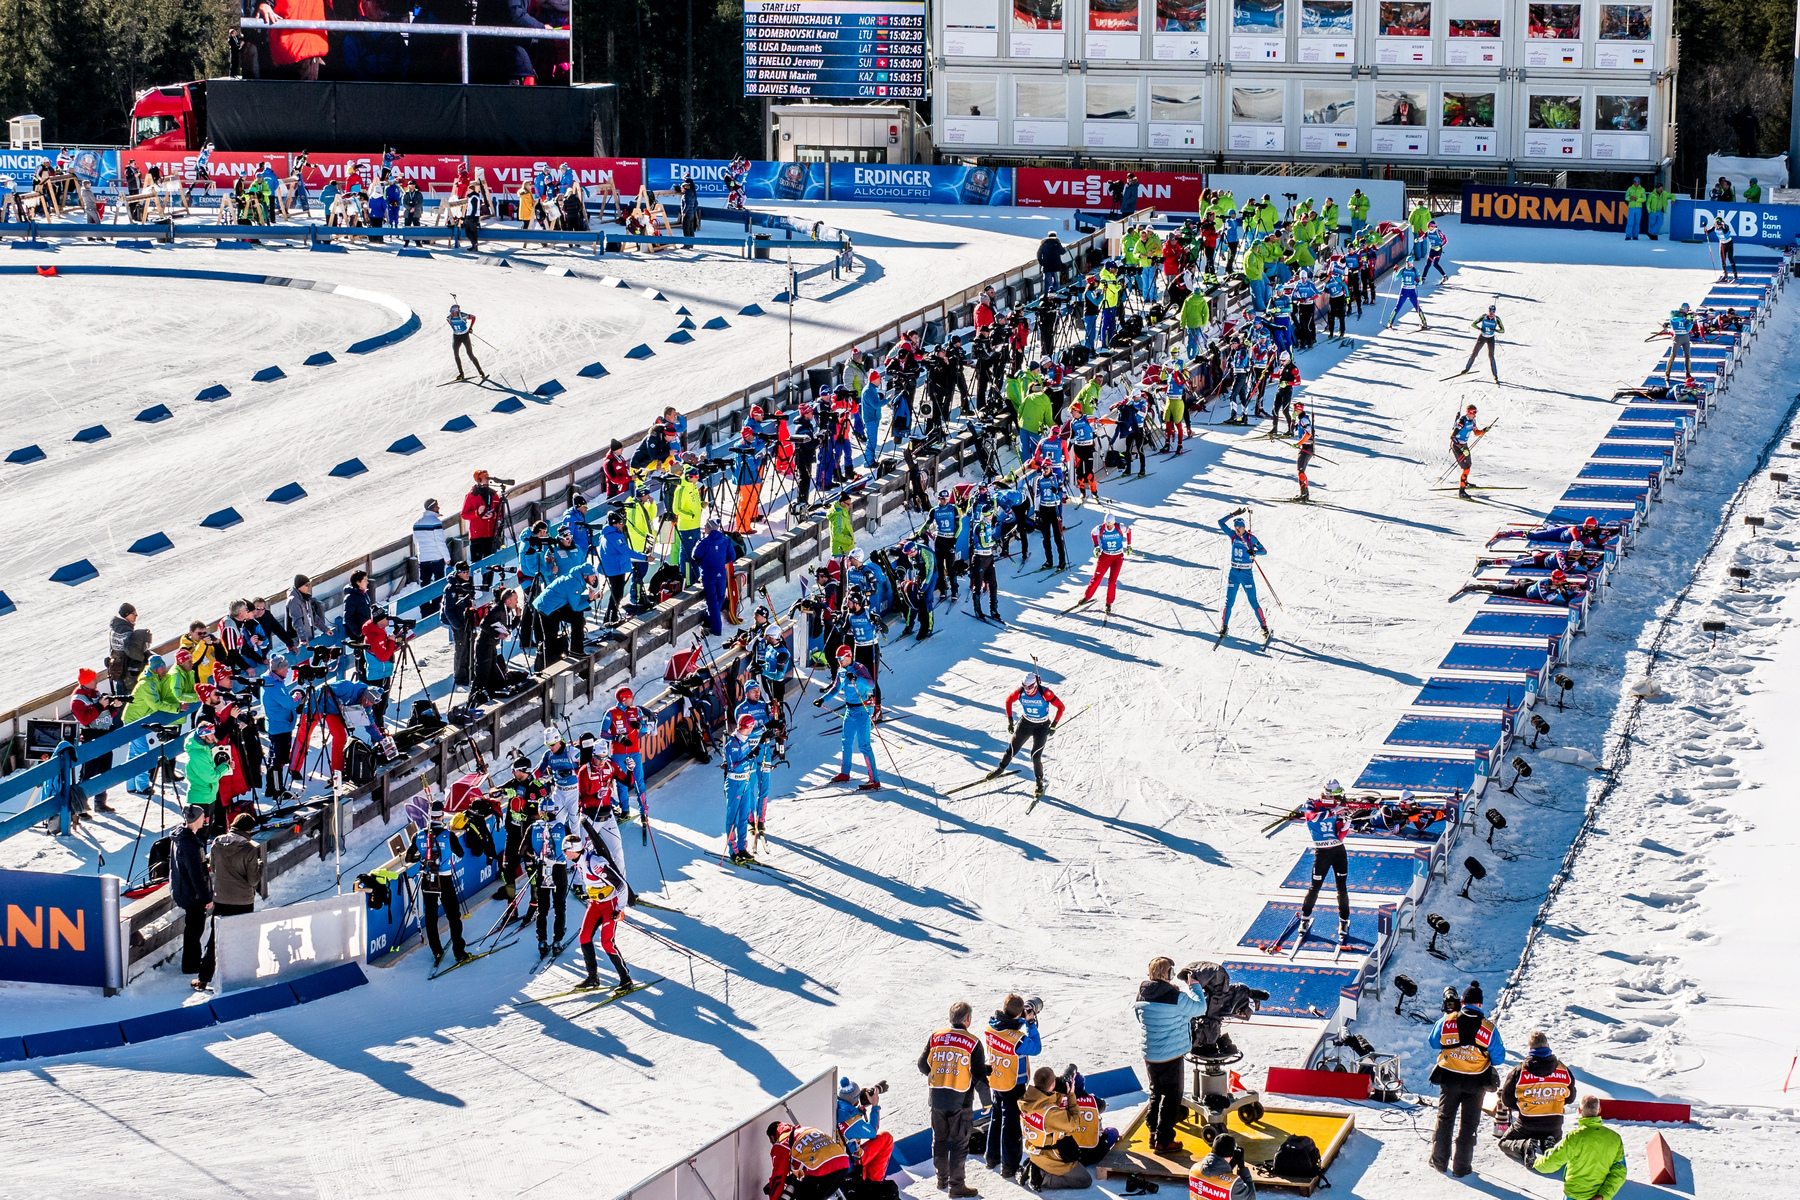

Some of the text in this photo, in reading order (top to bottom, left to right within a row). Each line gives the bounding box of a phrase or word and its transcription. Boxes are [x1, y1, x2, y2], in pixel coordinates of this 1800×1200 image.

[762, 3, 801, 12] START LIST
[745, 14, 922, 26] 103 GJERMUNDSHAUG V. NOR 15:02:15
[745, 28, 922, 40] 104 DOMBROVSKI Karol LTU 15:02:30
[745, 42, 922, 54] 105 LUSA Daumants LAT 15:02:45
[745, 56, 922, 69] 106 FINELLO Jeremy SUI 15:03:00
[745, 70, 922, 82] 107 BRAUN Maxim KAZ 15:03:15
[745, 84, 757, 93] 108
[758, 84, 788, 94] DAVIES
[858, 86, 876, 95] CAN
[889, 86, 922, 97] 15:03:30
[854, 167, 932, 188] ERDINGER
[854, 188, 930, 197] ALKOHOLFREI
[1694, 208, 1758, 237] DKB
[1763, 212, 1778, 221] Das
[1762, 222, 1781, 230] kann
[1762, 231, 1781, 239] Bank
[1589, 579, 1594, 590] 9
[1570, 610, 1576, 622] 8
[1550, 642, 1556, 656] 7
[1528, 680, 1534, 692] 6
[1505, 718, 1511, 731] 5
[1478, 762, 1484, 775] 4
[1450, 807, 1455, 822] 3
[480, 865, 492, 883] DKB
[1418, 860, 1424, 876] 2
[1383, 917, 1388, 934] 1
[370, 934, 387, 954] DKB
[933, 1034, 973, 1048] VIESSMANN
[932, 1050, 969, 1066] PHOTO
